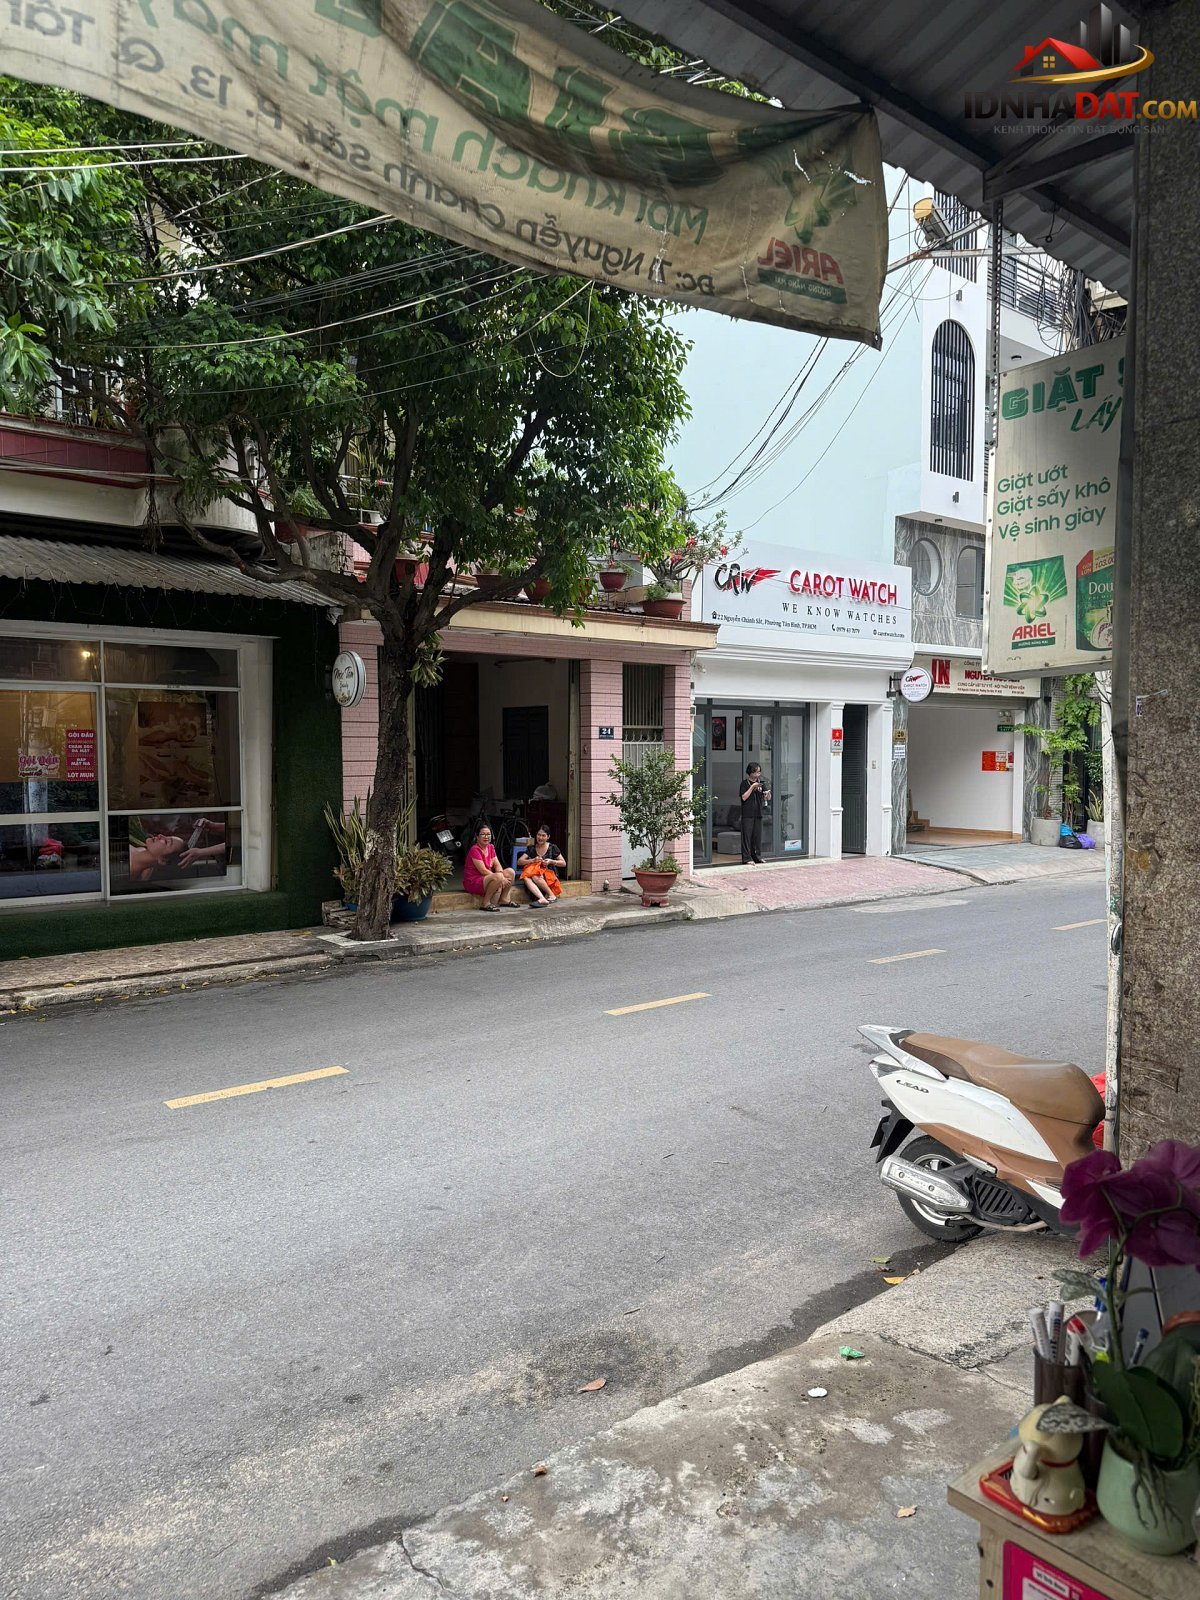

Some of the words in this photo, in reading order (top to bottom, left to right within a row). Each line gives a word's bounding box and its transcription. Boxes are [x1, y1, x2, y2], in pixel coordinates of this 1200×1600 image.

[1002, 363, 1105, 420] GIẶT
[997, 472, 1034, 494] Giặt
[1037, 464, 1068, 484] ướt
[997, 494, 1033, 516] Giặt
[1037, 484, 1070, 508] sấy
[1075, 476, 1111, 499] khô
[998, 521, 1020, 542] Vệ
[1024, 515, 1060, 534] sinh
[1065, 506, 1106, 531] giày
[789, 569, 845, 599] CAROT
[848, 577, 898, 605] WATCH
[782, 602, 798, 614] WE
[807, 605, 841, 618] KNOW
[847, 610, 897, 625] WATCHES
[1011, 622, 1056, 641] ARIEL
